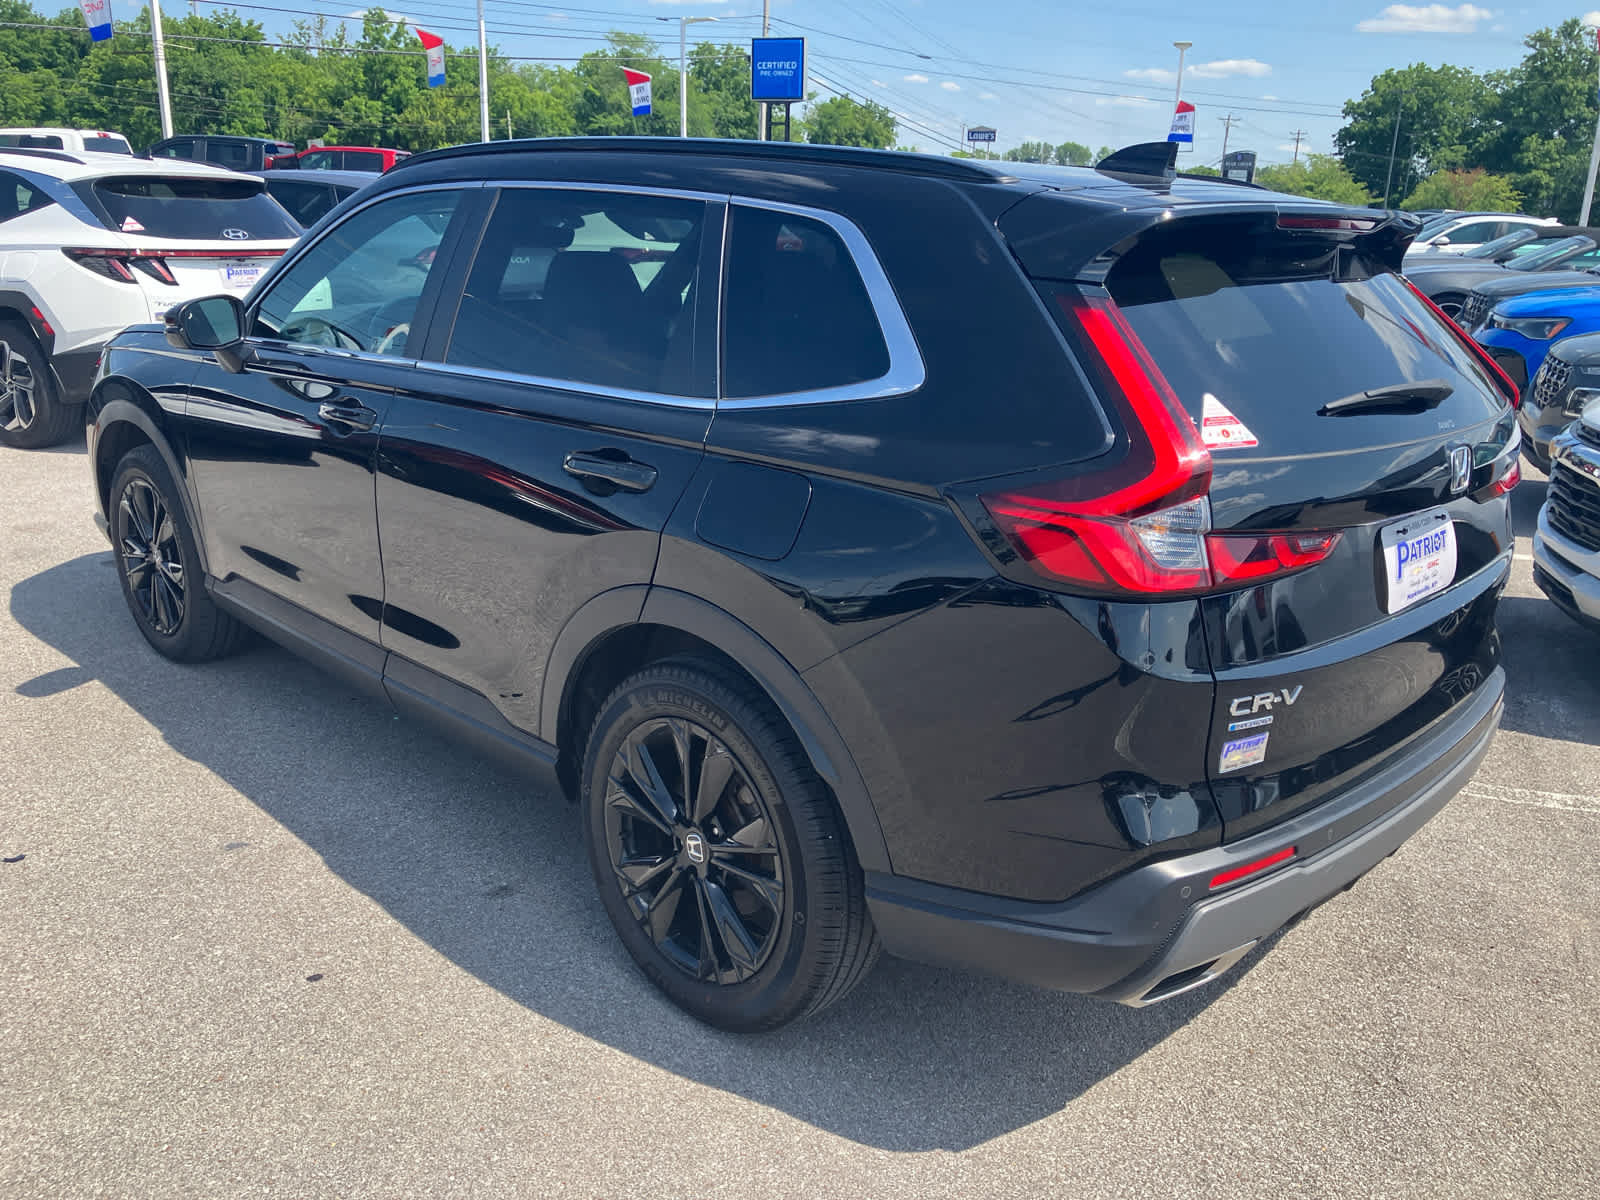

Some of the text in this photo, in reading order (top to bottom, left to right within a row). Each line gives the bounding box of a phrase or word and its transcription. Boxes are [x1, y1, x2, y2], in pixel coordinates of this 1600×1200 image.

[757, 61, 798, 70] CERTIFIED
[1396, 529, 1447, 580] PATRIOT
[657, 689, 727, 729] MICHELIN
[1229, 684, 1304, 717] CR-V
